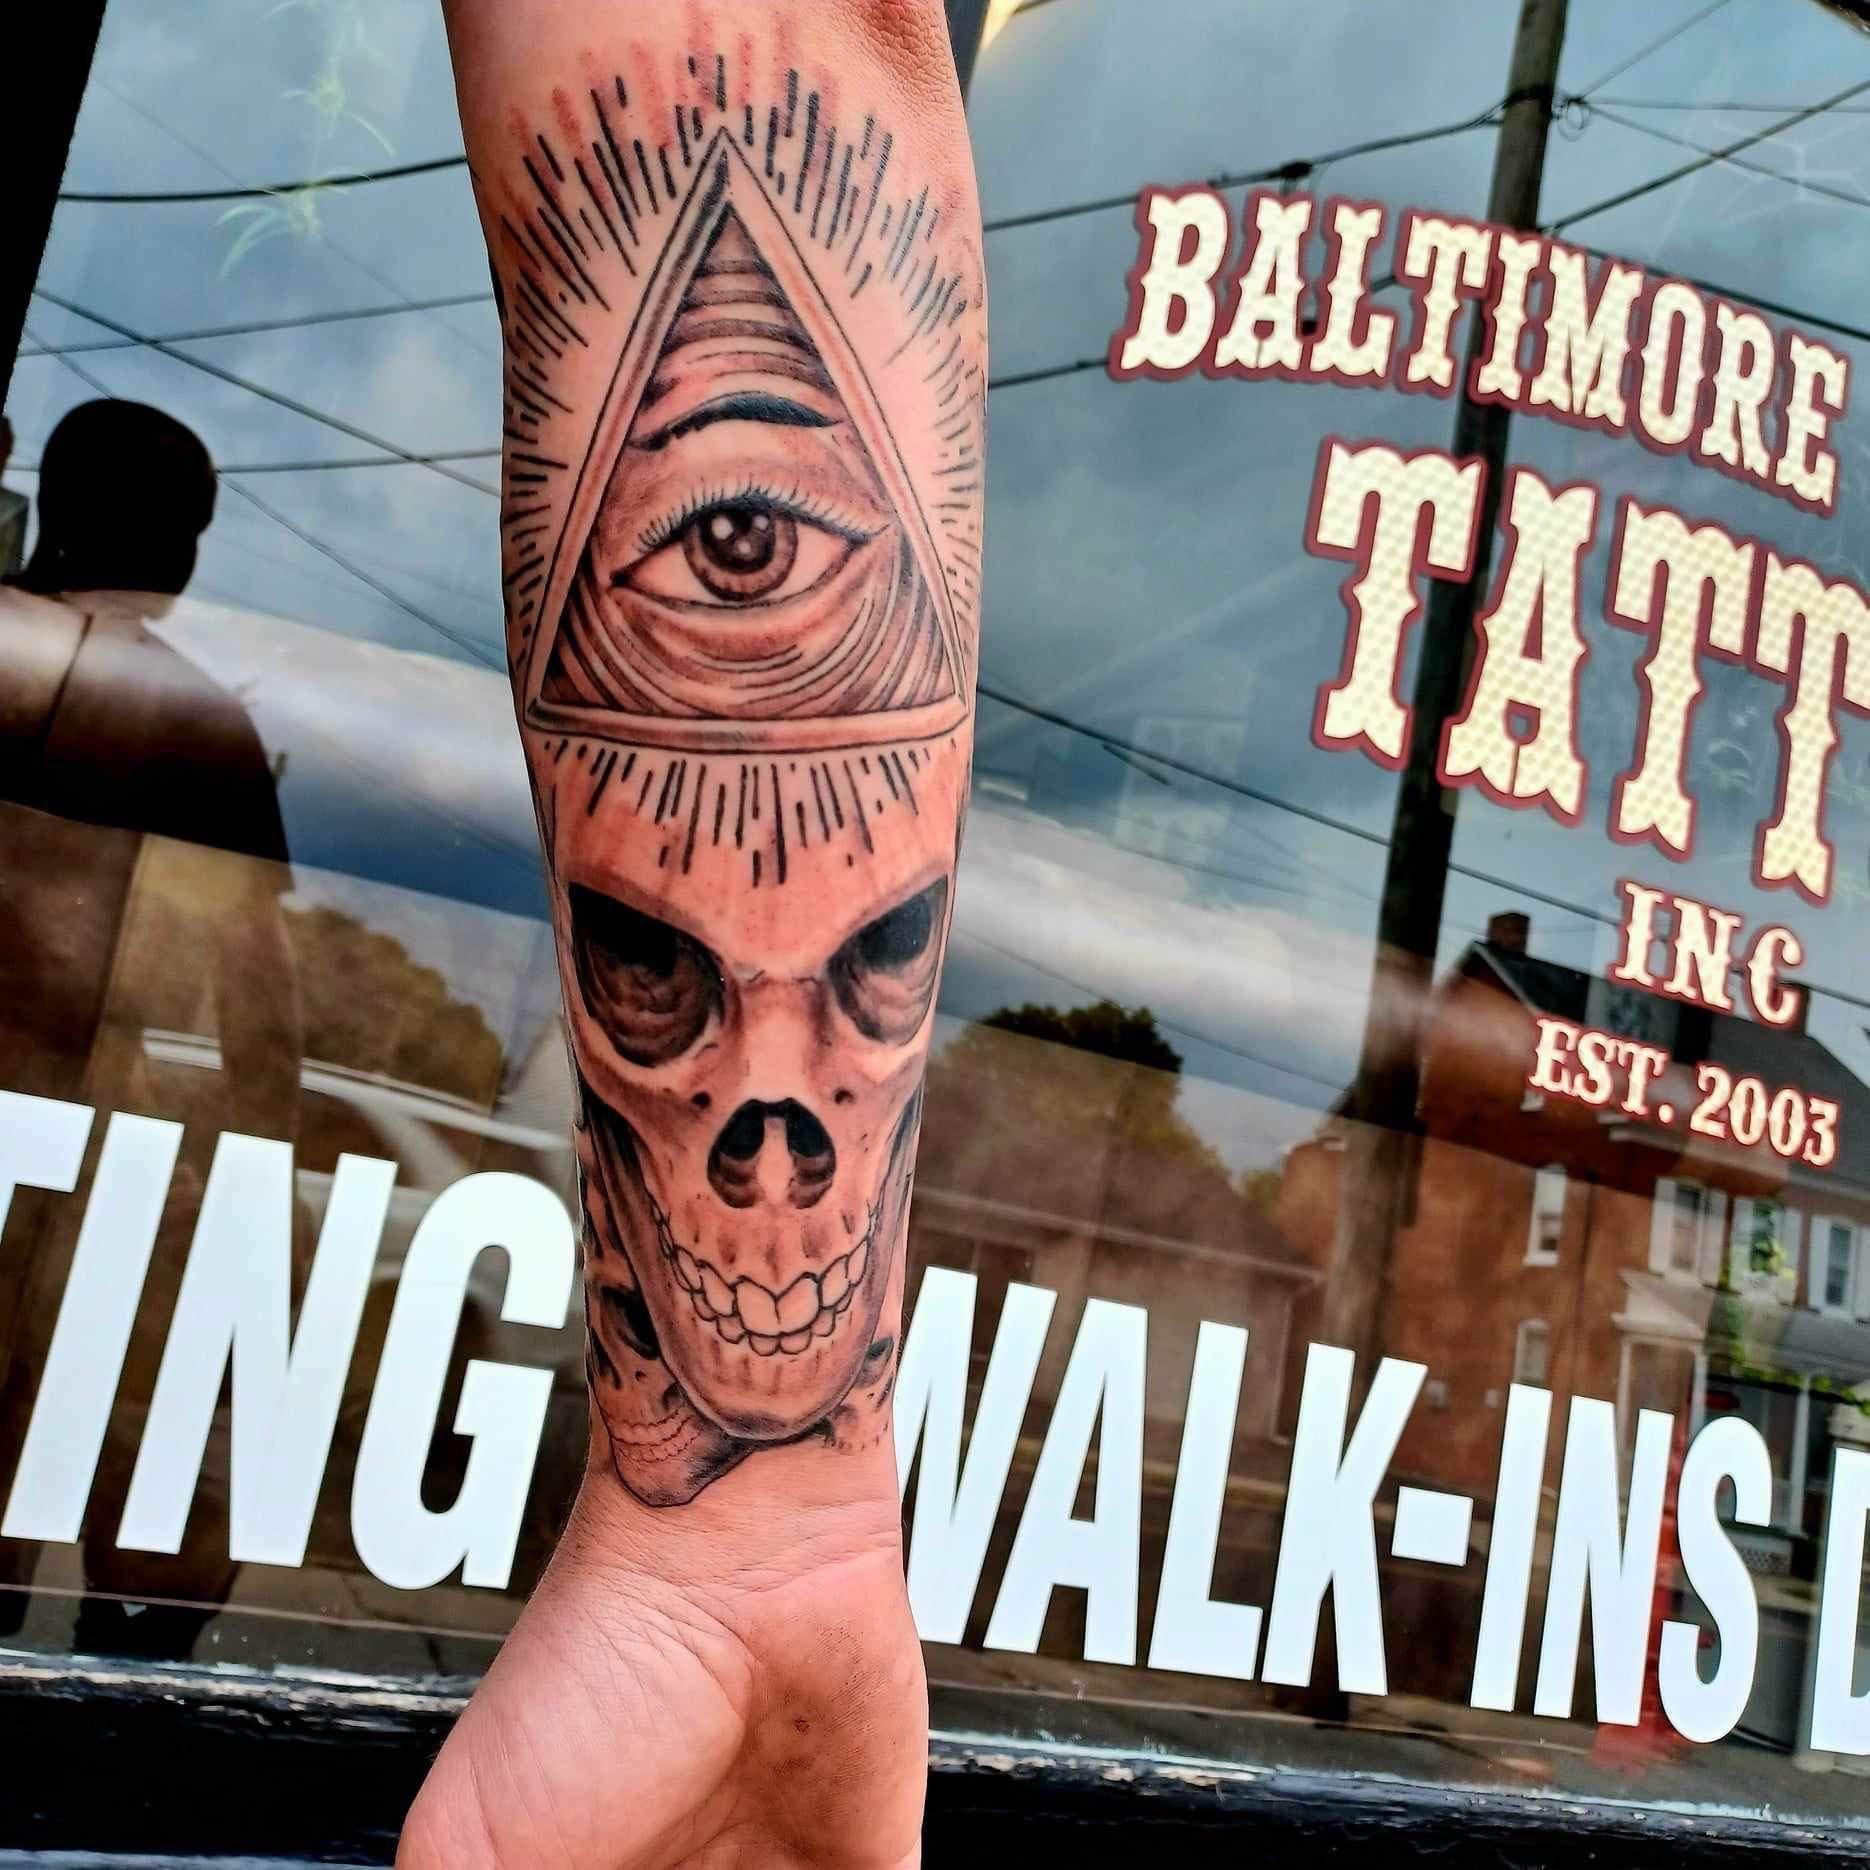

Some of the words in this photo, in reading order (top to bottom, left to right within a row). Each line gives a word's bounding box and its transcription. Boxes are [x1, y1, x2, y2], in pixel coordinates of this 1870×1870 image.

[1118, 189, 1850, 510] BALTIMORE
[1313, 439, 1870, 900] TATT
[1528, 1017, 1675, 1124] EST.
[1689, 1064, 1840, 1167] 2003
[1614, 880, 1802, 1025] INC
[0, 1089, 576, 1590] ING
